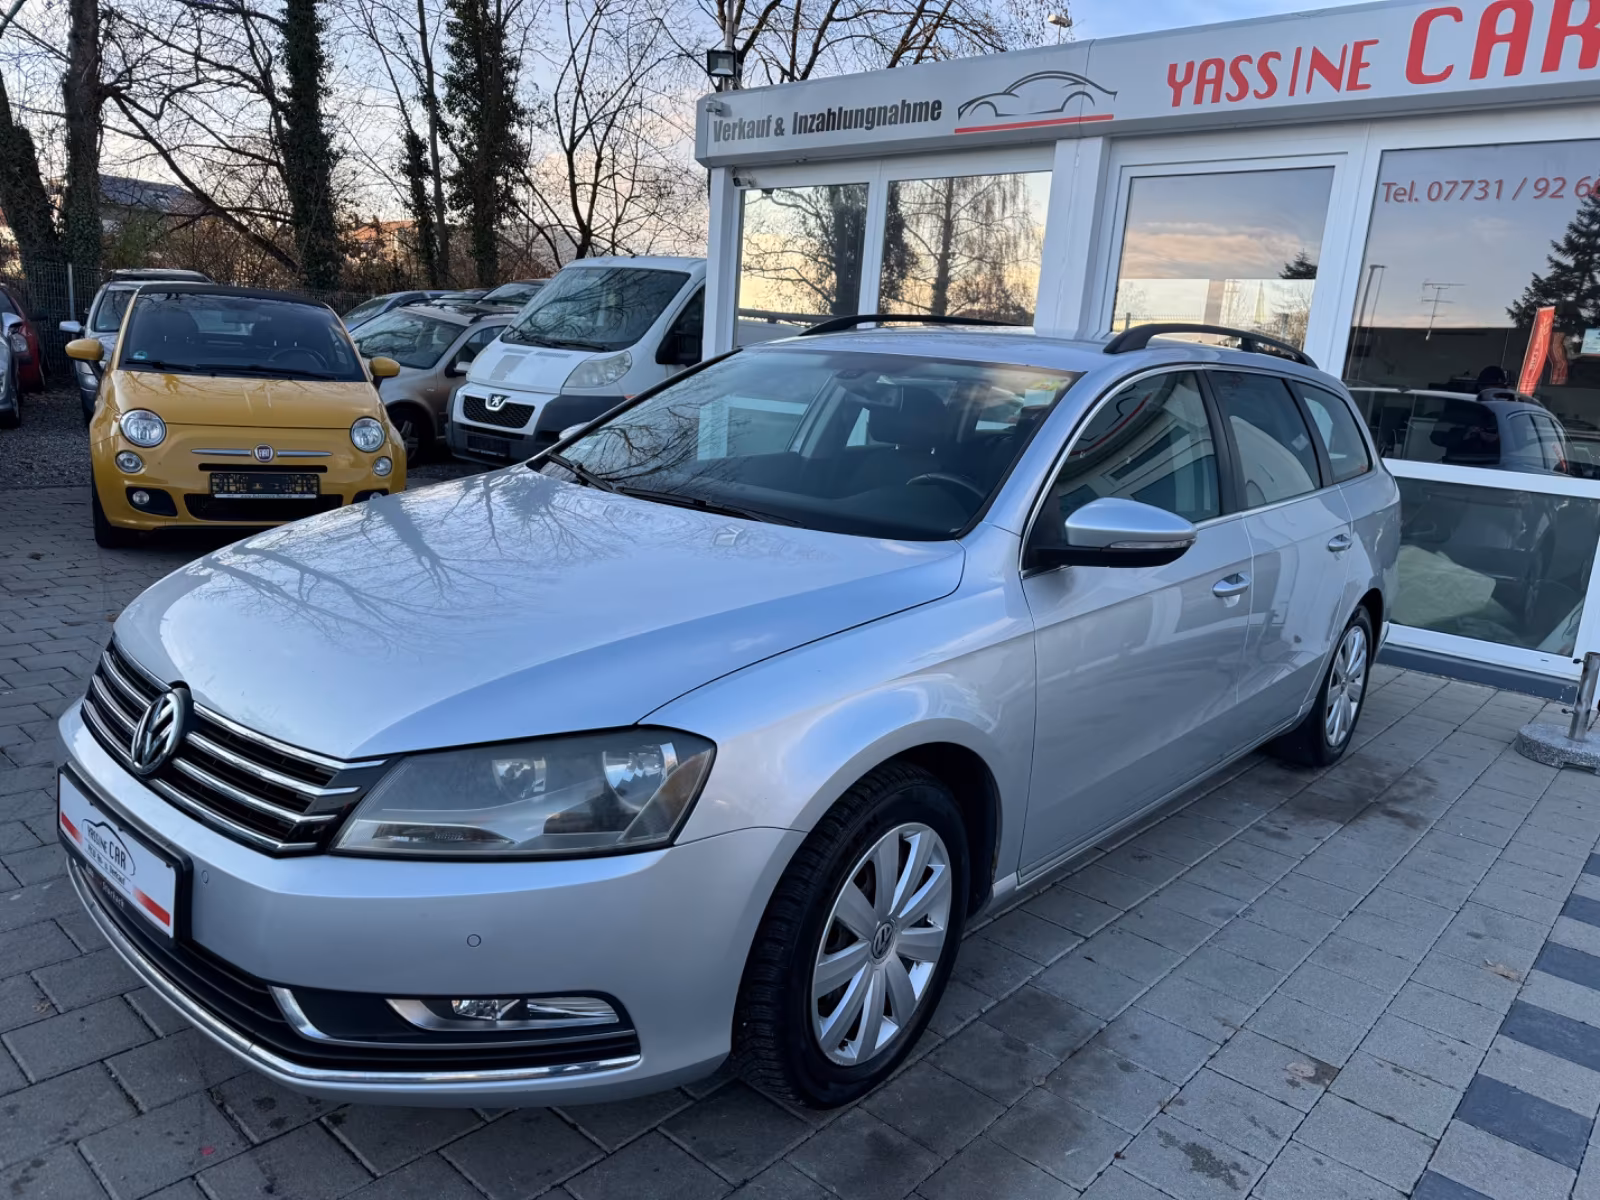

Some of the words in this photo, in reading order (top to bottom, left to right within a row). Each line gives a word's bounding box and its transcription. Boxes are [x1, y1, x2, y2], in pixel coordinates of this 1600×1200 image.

[1167, 39, 1379, 107] YASSINE
[1405, 0, 1600, 85] CAR
[713, 114, 772, 142] Verkauf
[774, 118, 785, 136] &
[792, 99, 942, 135] Inzahlungnahme
[1382, 180, 1418, 203] Tel.
[1427, 179, 1504, 202] 07731
[1512, 177, 1528, 200] /
[1533, 177, 1567, 199] 92
[109, 841, 126, 871] CAR
